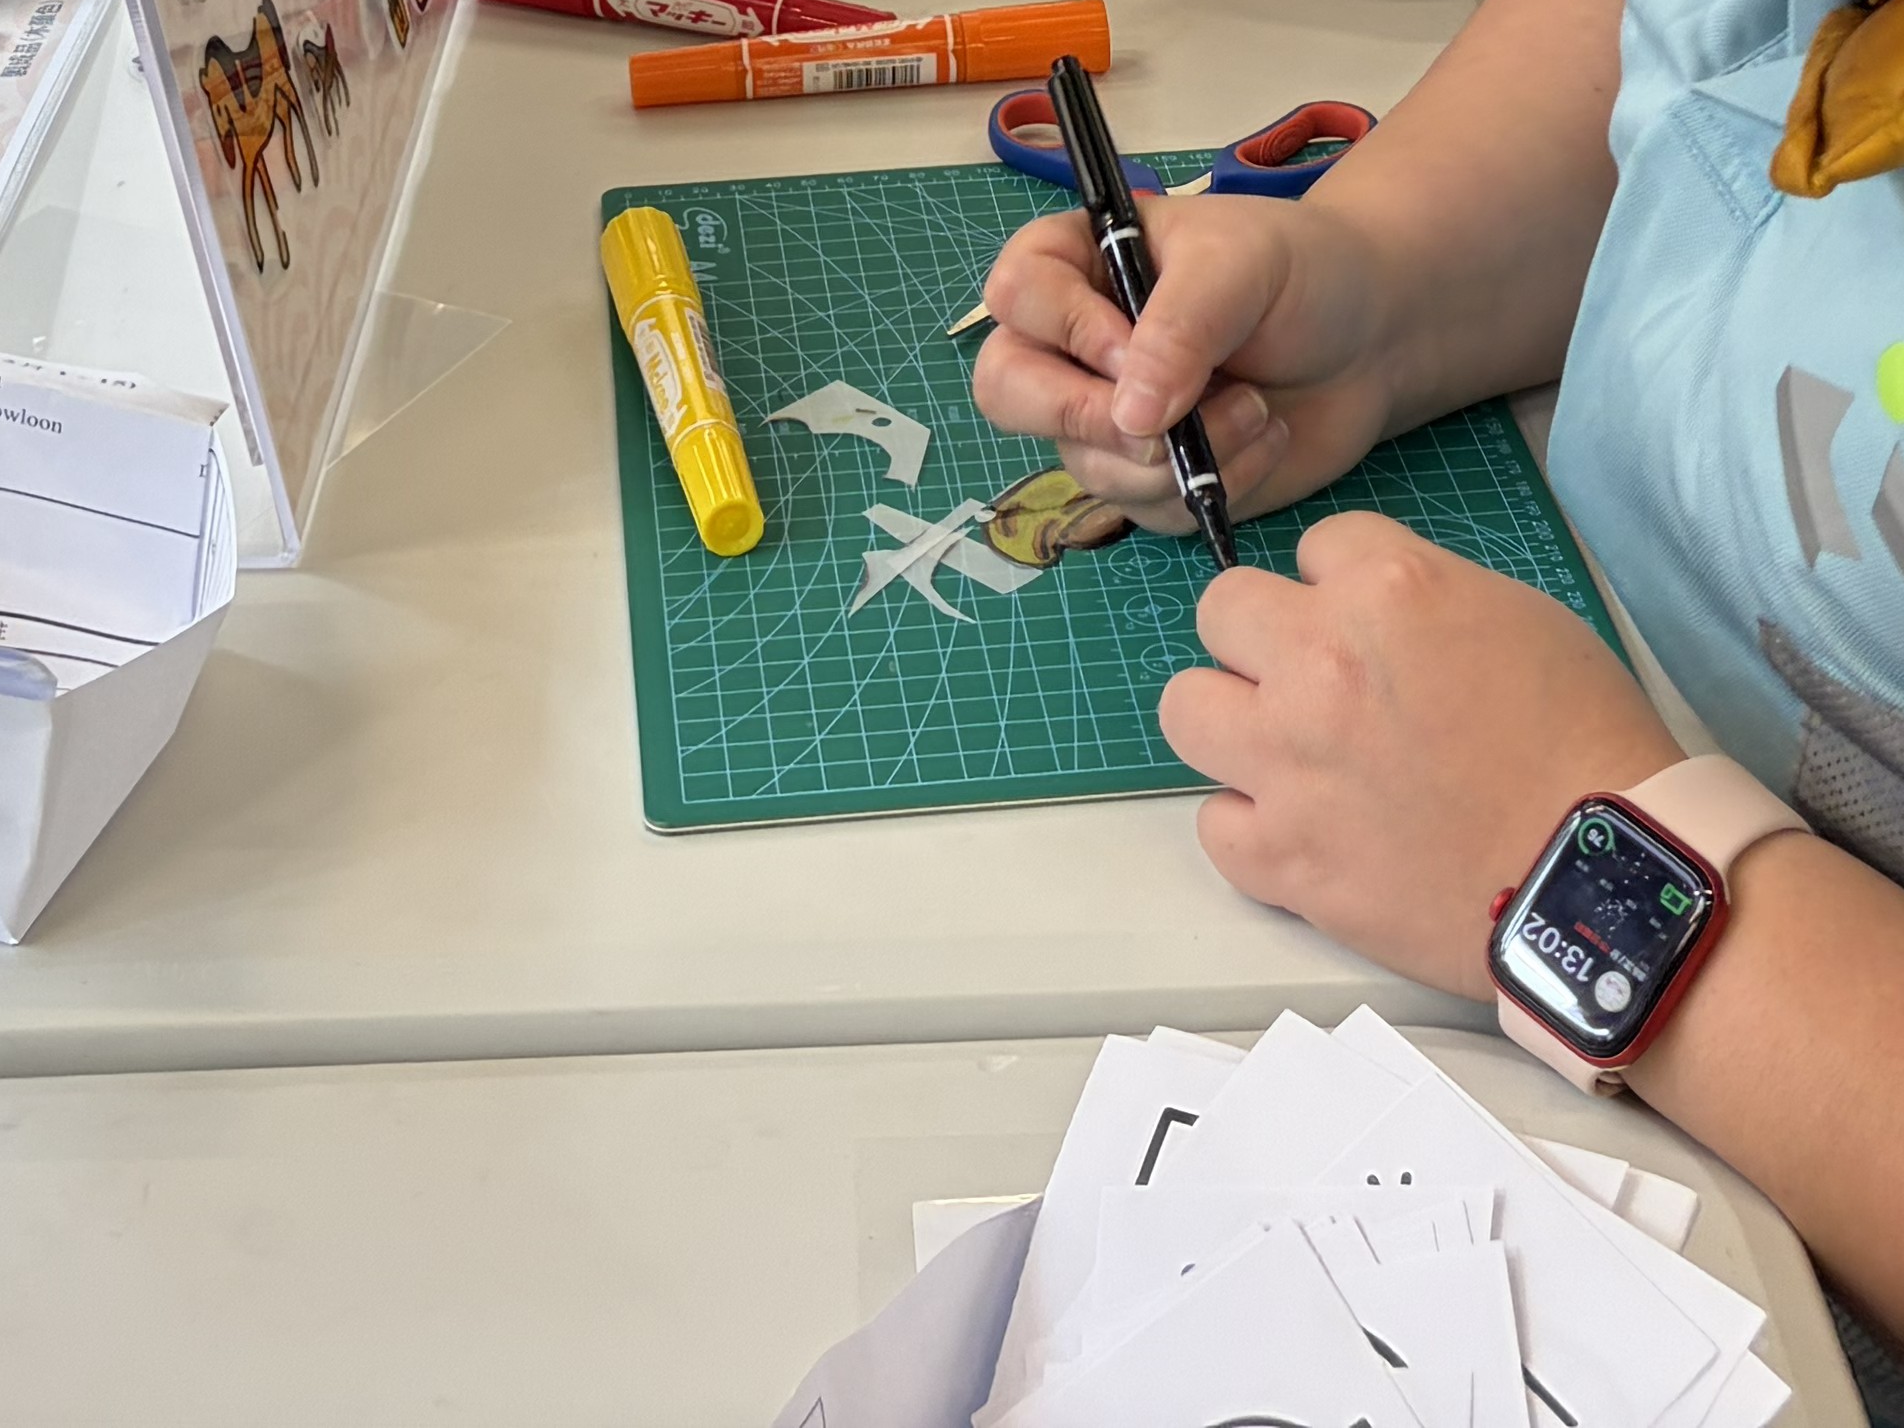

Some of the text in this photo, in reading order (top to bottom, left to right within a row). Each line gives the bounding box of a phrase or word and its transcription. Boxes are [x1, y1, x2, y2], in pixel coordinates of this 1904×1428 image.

[645, 0, 728, 27] マッキー
[1522, 911, 1595, 983] 13:02
